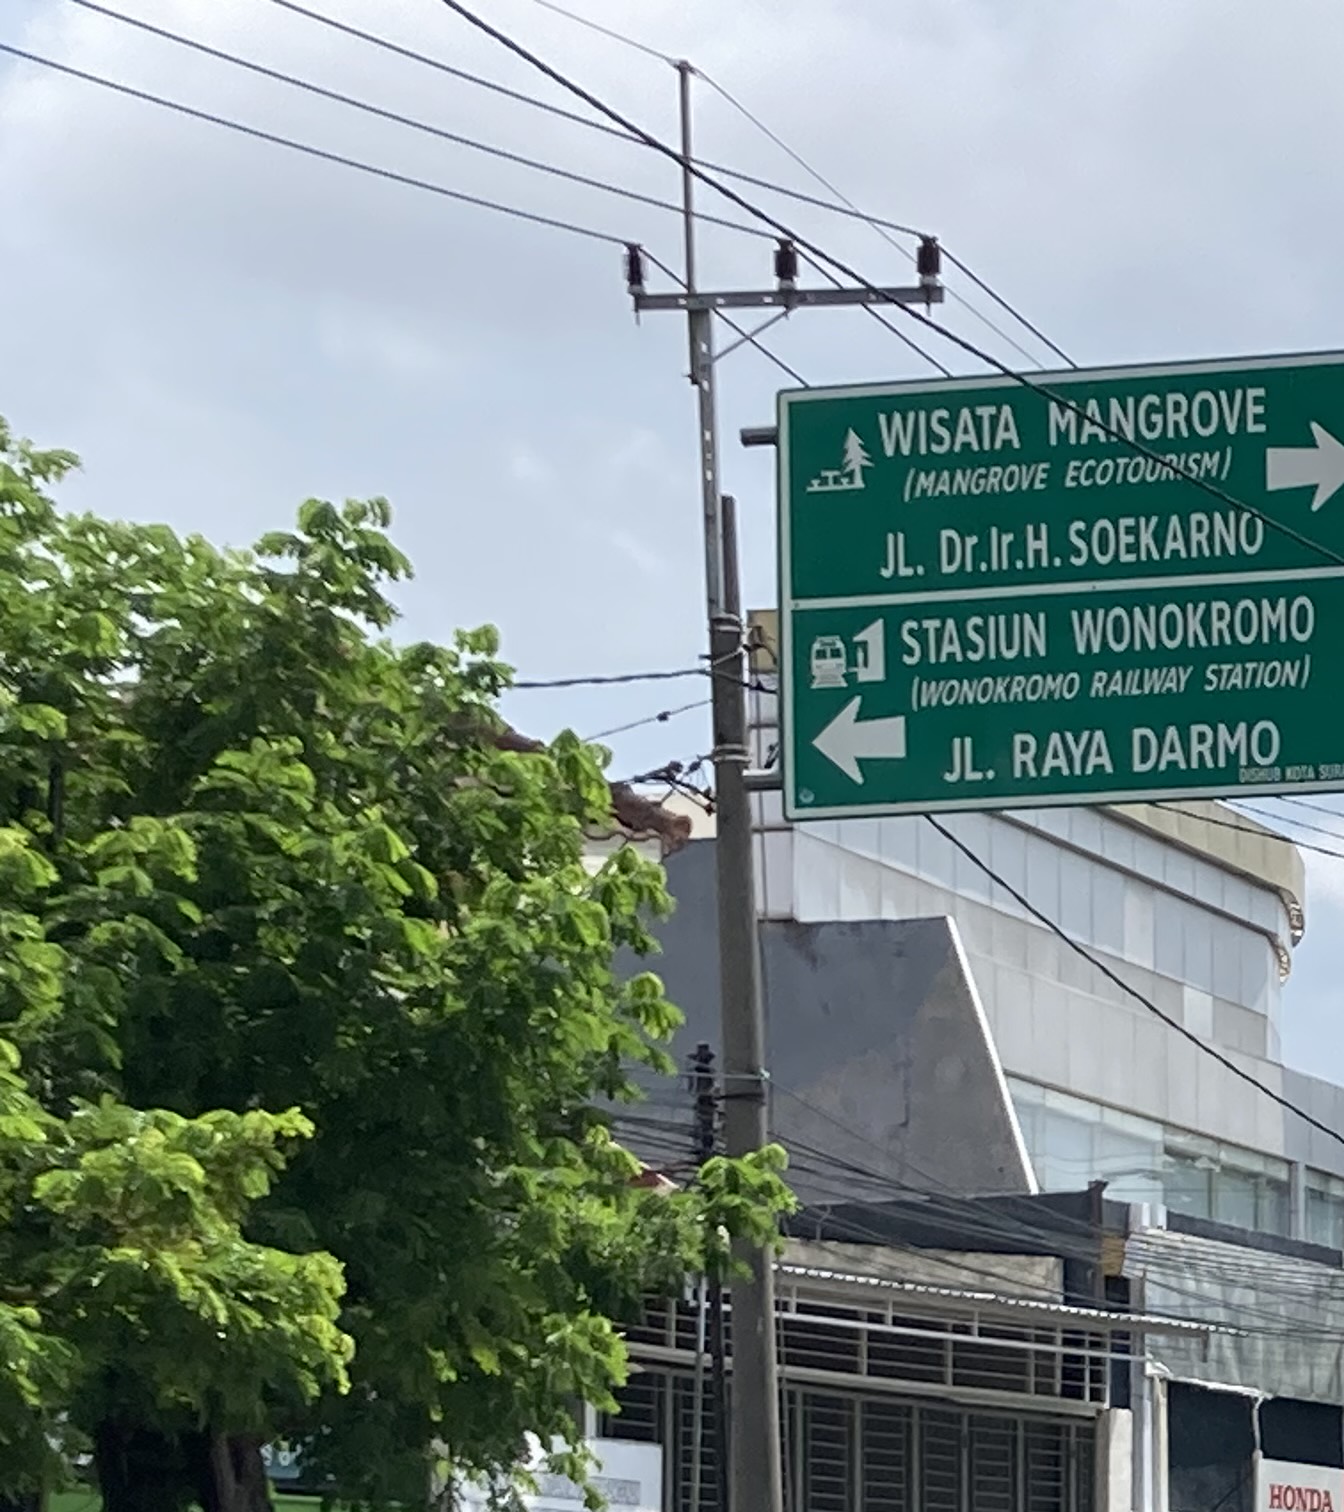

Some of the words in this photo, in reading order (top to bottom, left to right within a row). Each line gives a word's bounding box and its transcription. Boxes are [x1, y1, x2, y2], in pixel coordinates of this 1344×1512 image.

[878, 403, 1021, 457] WISATA
[1048, 388, 1267, 446] MANGROVE
[904, 462, 1050, 503] (MANGROVE
[1065, 446, 1232, 488] ECOTOURISM)
[879, 531, 925, 579] JL.
[1069, 510, 1265, 567] SOEKARNO
[901, 612, 1047, 666] STASIUN
[1071, 595, 1315, 656] WONOKROMO
[911, 671, 1080, 712] (WONOKROMO
[1090, 665, 1193, 698] RAILWAY
[1204, 653, 1310, 692] STATION)
[943, 736, 996, 783] JL.
[1013, 730, 1114, 778] RAYA
[1132, 720, 1282, 774] DARMO
